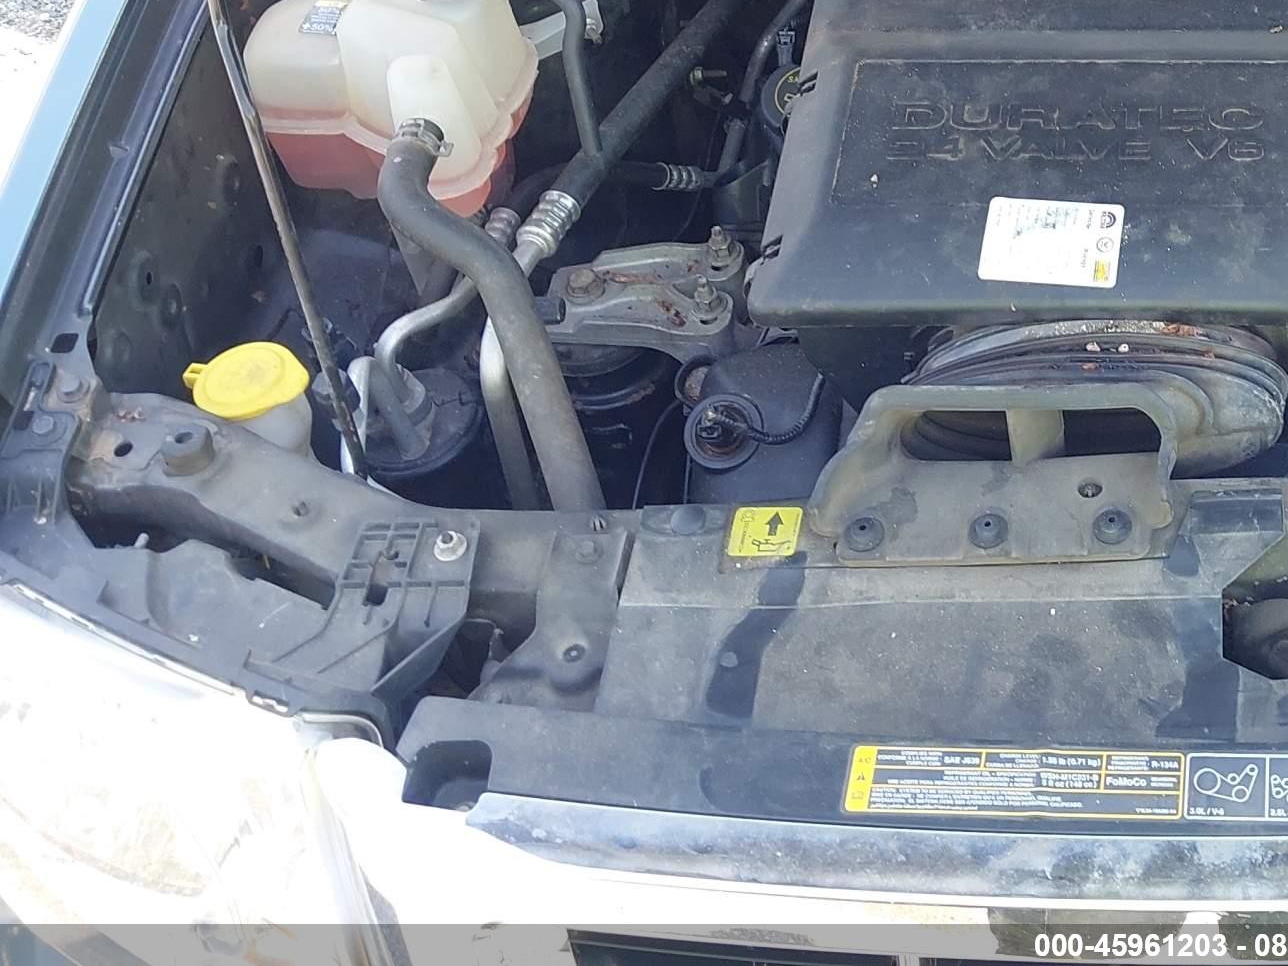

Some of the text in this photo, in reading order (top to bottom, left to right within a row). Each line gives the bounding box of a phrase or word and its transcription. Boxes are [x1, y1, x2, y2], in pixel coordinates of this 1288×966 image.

[892, 101, 1264, 132] DURATEC
[982, 136, 1153, 161] VALVE
[1185, 136, 1265, 162] V6
[1151, 761, 1179, 769] R-134A
[1106, 777, 1147, 787] FoMoCo
